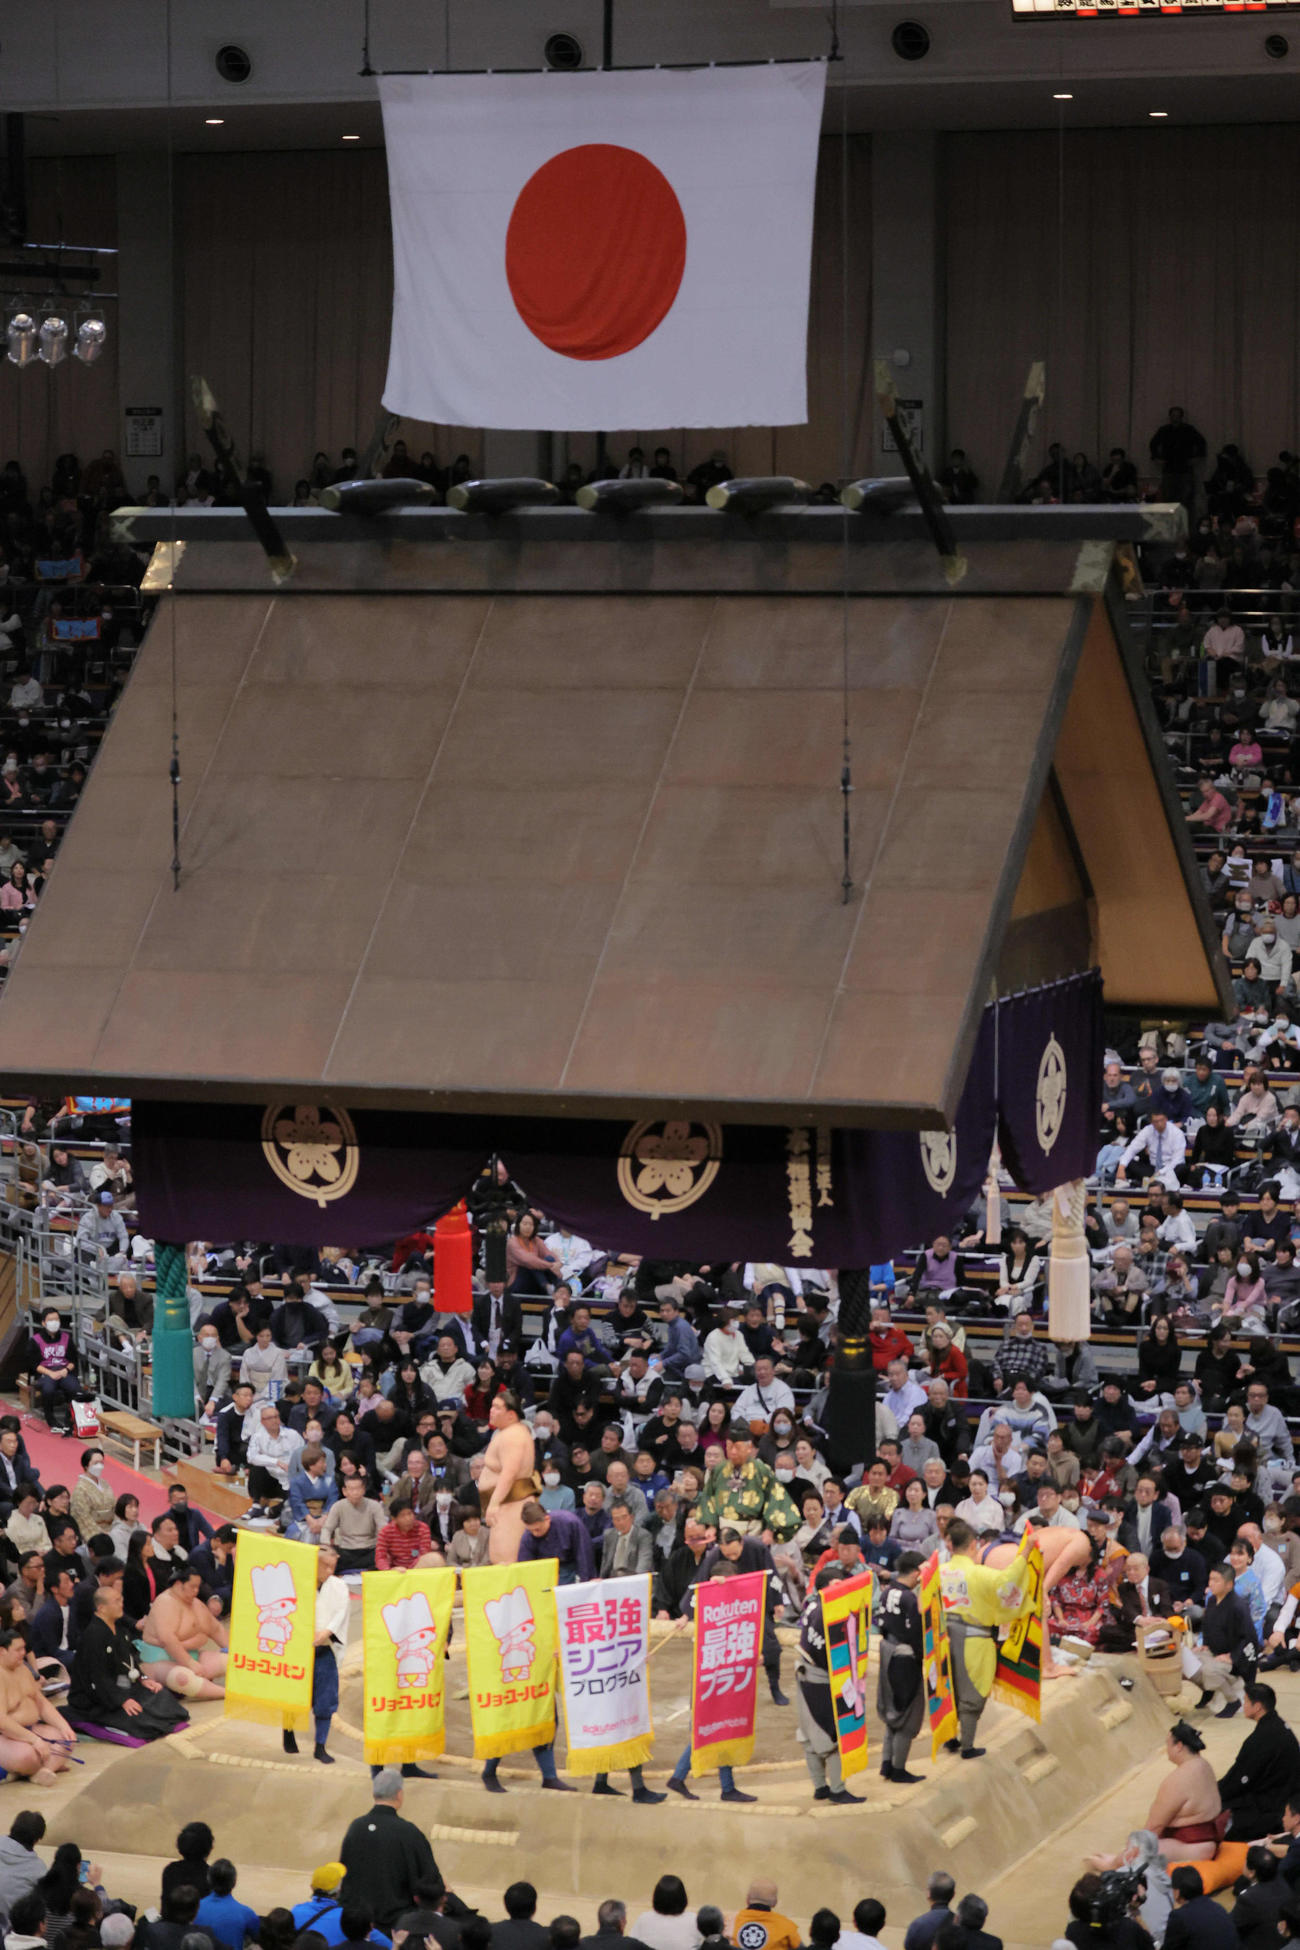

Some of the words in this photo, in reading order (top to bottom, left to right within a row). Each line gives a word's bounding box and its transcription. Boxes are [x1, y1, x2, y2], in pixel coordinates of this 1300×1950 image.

[565, 1597, 642, 1645] 最強
[703, 1599, 758, 1625] Rakuten
[568, 1639, 642, 1677] シニア
[701, 1620, 756, 1670] 最強
[234, 1653, 305, 1680] リョーユーパン
[570, 1670, 641, 1697] プログラム
[700, 1665, 752, 1701] プラン
